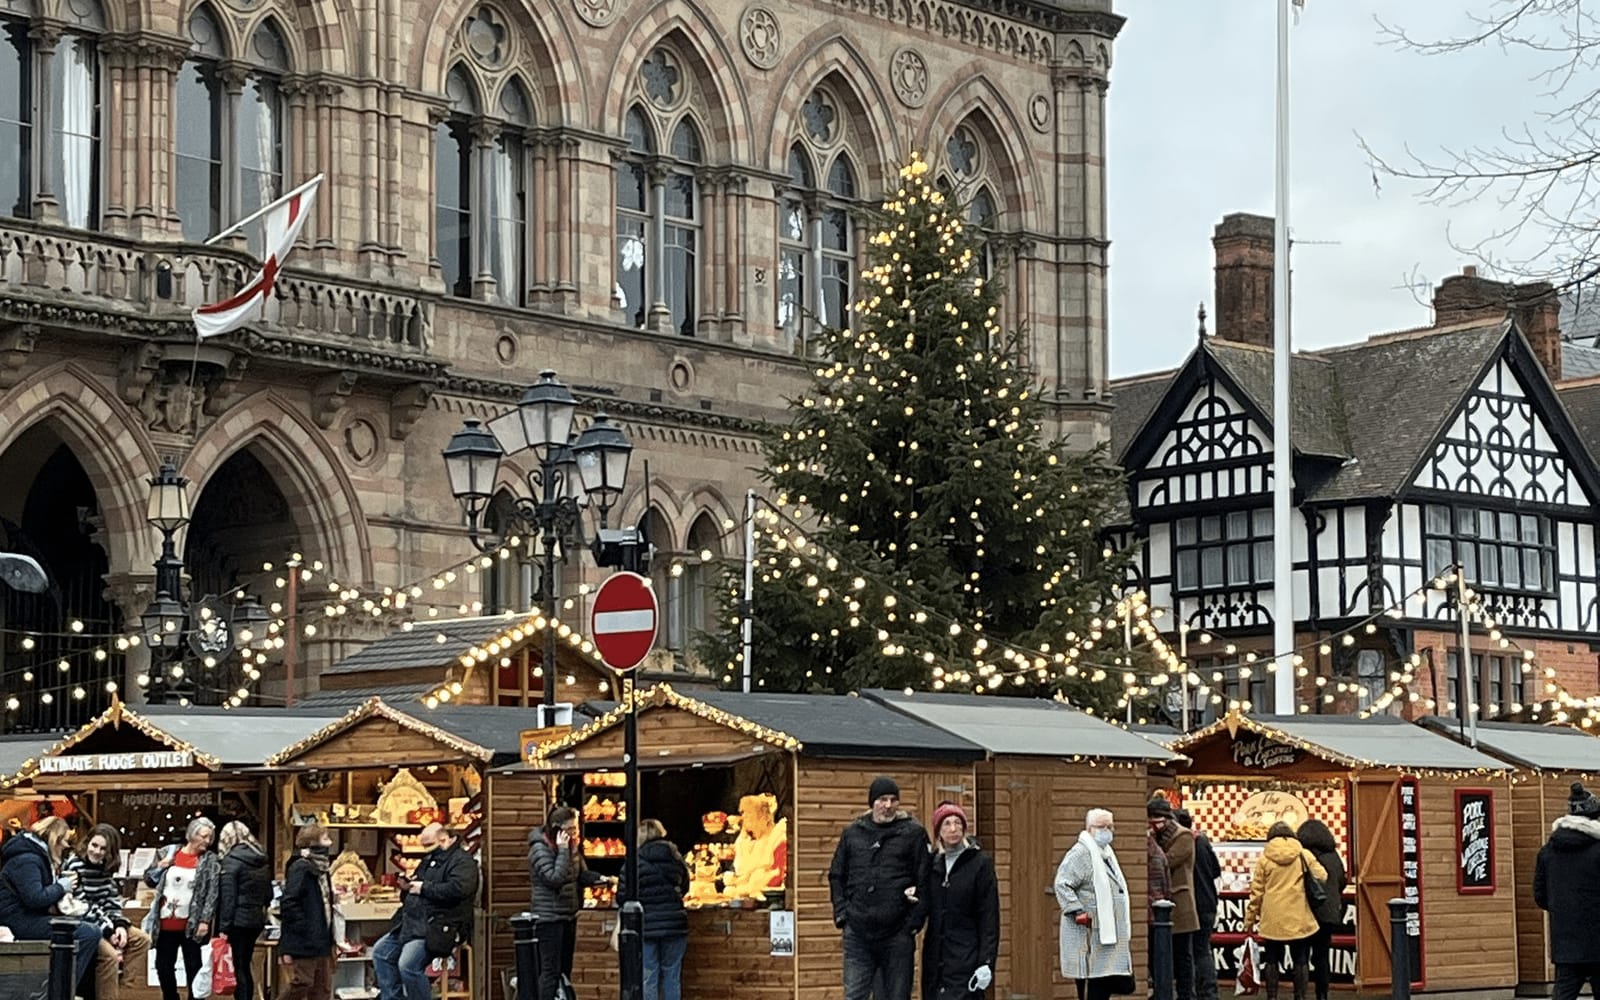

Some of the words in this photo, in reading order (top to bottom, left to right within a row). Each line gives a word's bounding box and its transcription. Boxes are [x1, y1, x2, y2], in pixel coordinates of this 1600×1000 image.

[39, 755, 93, 773] ULTIMATE
[99, 753, 137, 770] FUDGE
[142, 751, 189, 768] OUTLET
[122, 793, 176, 806] HOMEMADE
[179, 792, 213, 806] FUDGE
